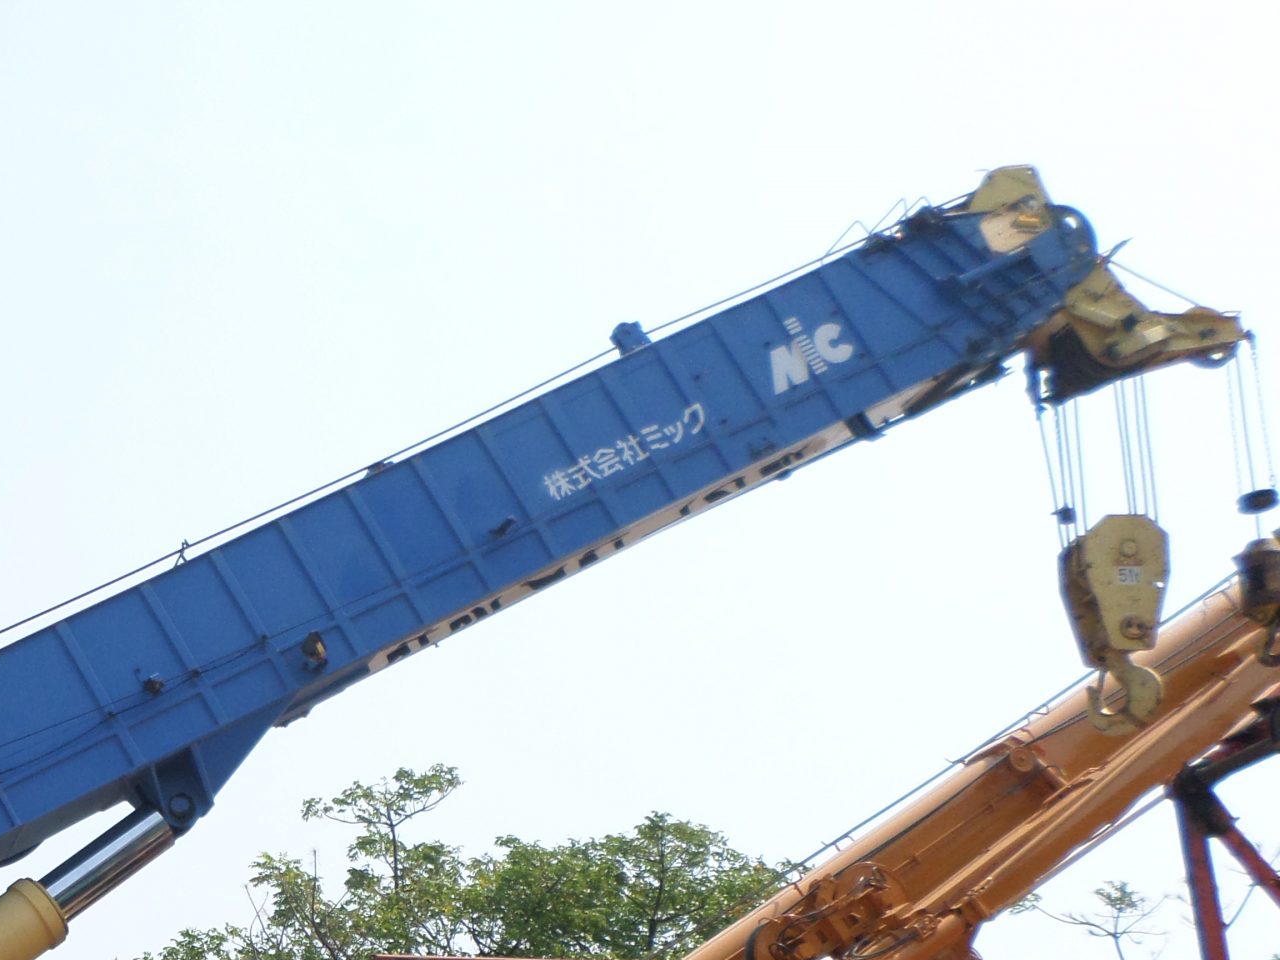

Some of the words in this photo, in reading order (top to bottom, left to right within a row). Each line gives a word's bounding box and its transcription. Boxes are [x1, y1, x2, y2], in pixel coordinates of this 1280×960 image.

[543, 403, 705, 500] 株式会社ミック
